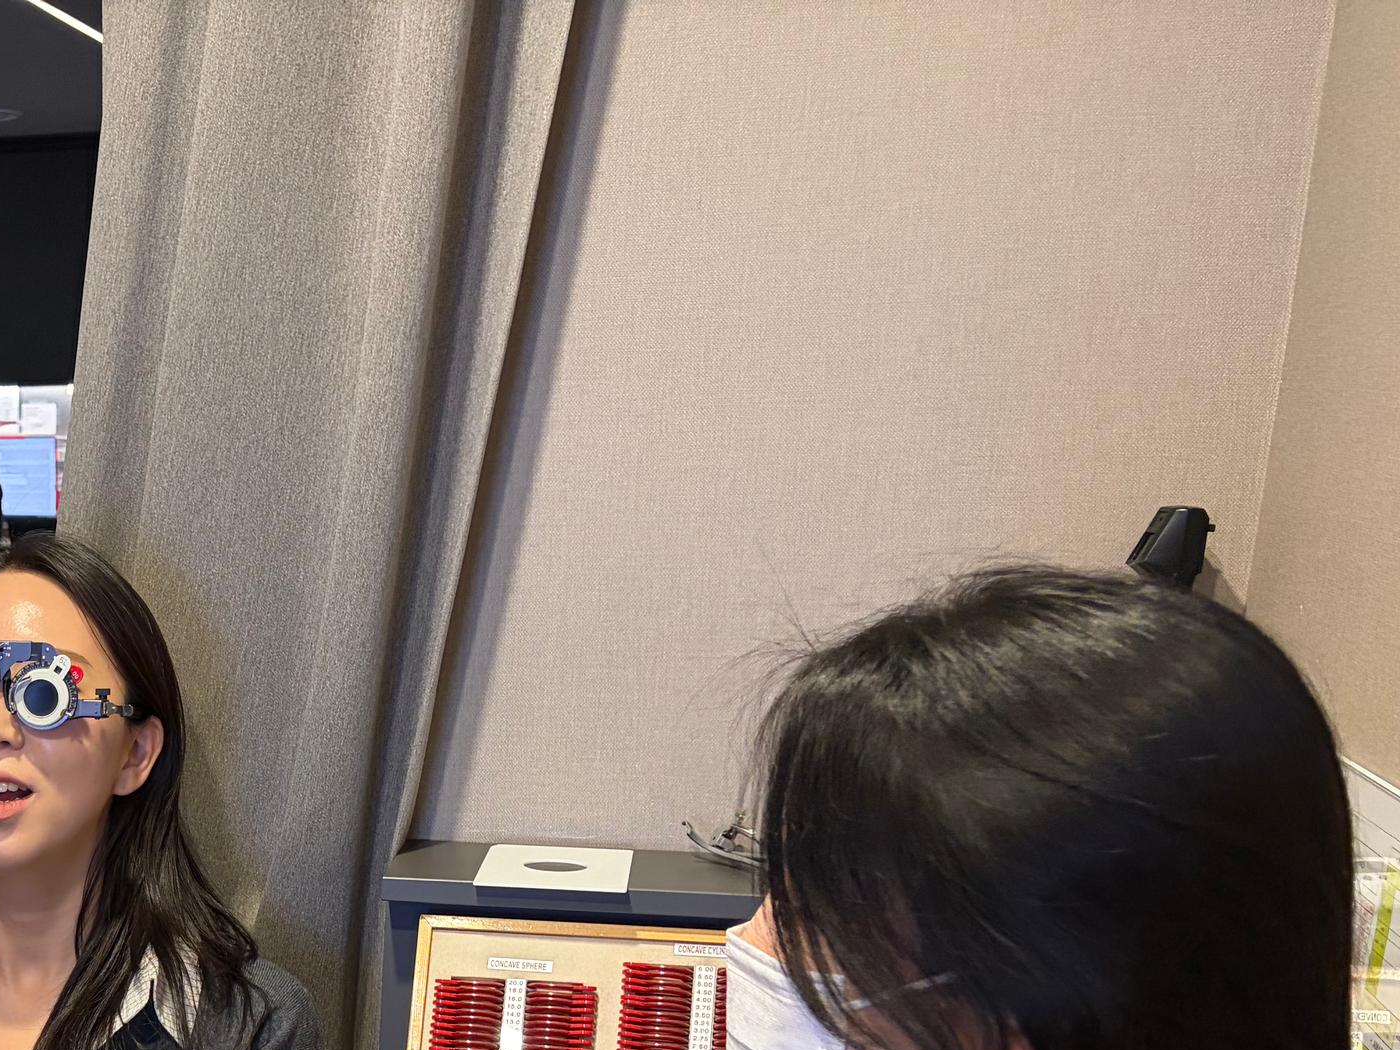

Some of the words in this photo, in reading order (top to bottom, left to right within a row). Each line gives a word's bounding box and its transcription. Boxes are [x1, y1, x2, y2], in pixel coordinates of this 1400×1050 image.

[678, 945, 707, 955] CONCAVE
[707, 947, 727, 955] CYLIN
[490, 959, 520, 969] CONCAVE
[521, 961, 547, 971] SPHERE
